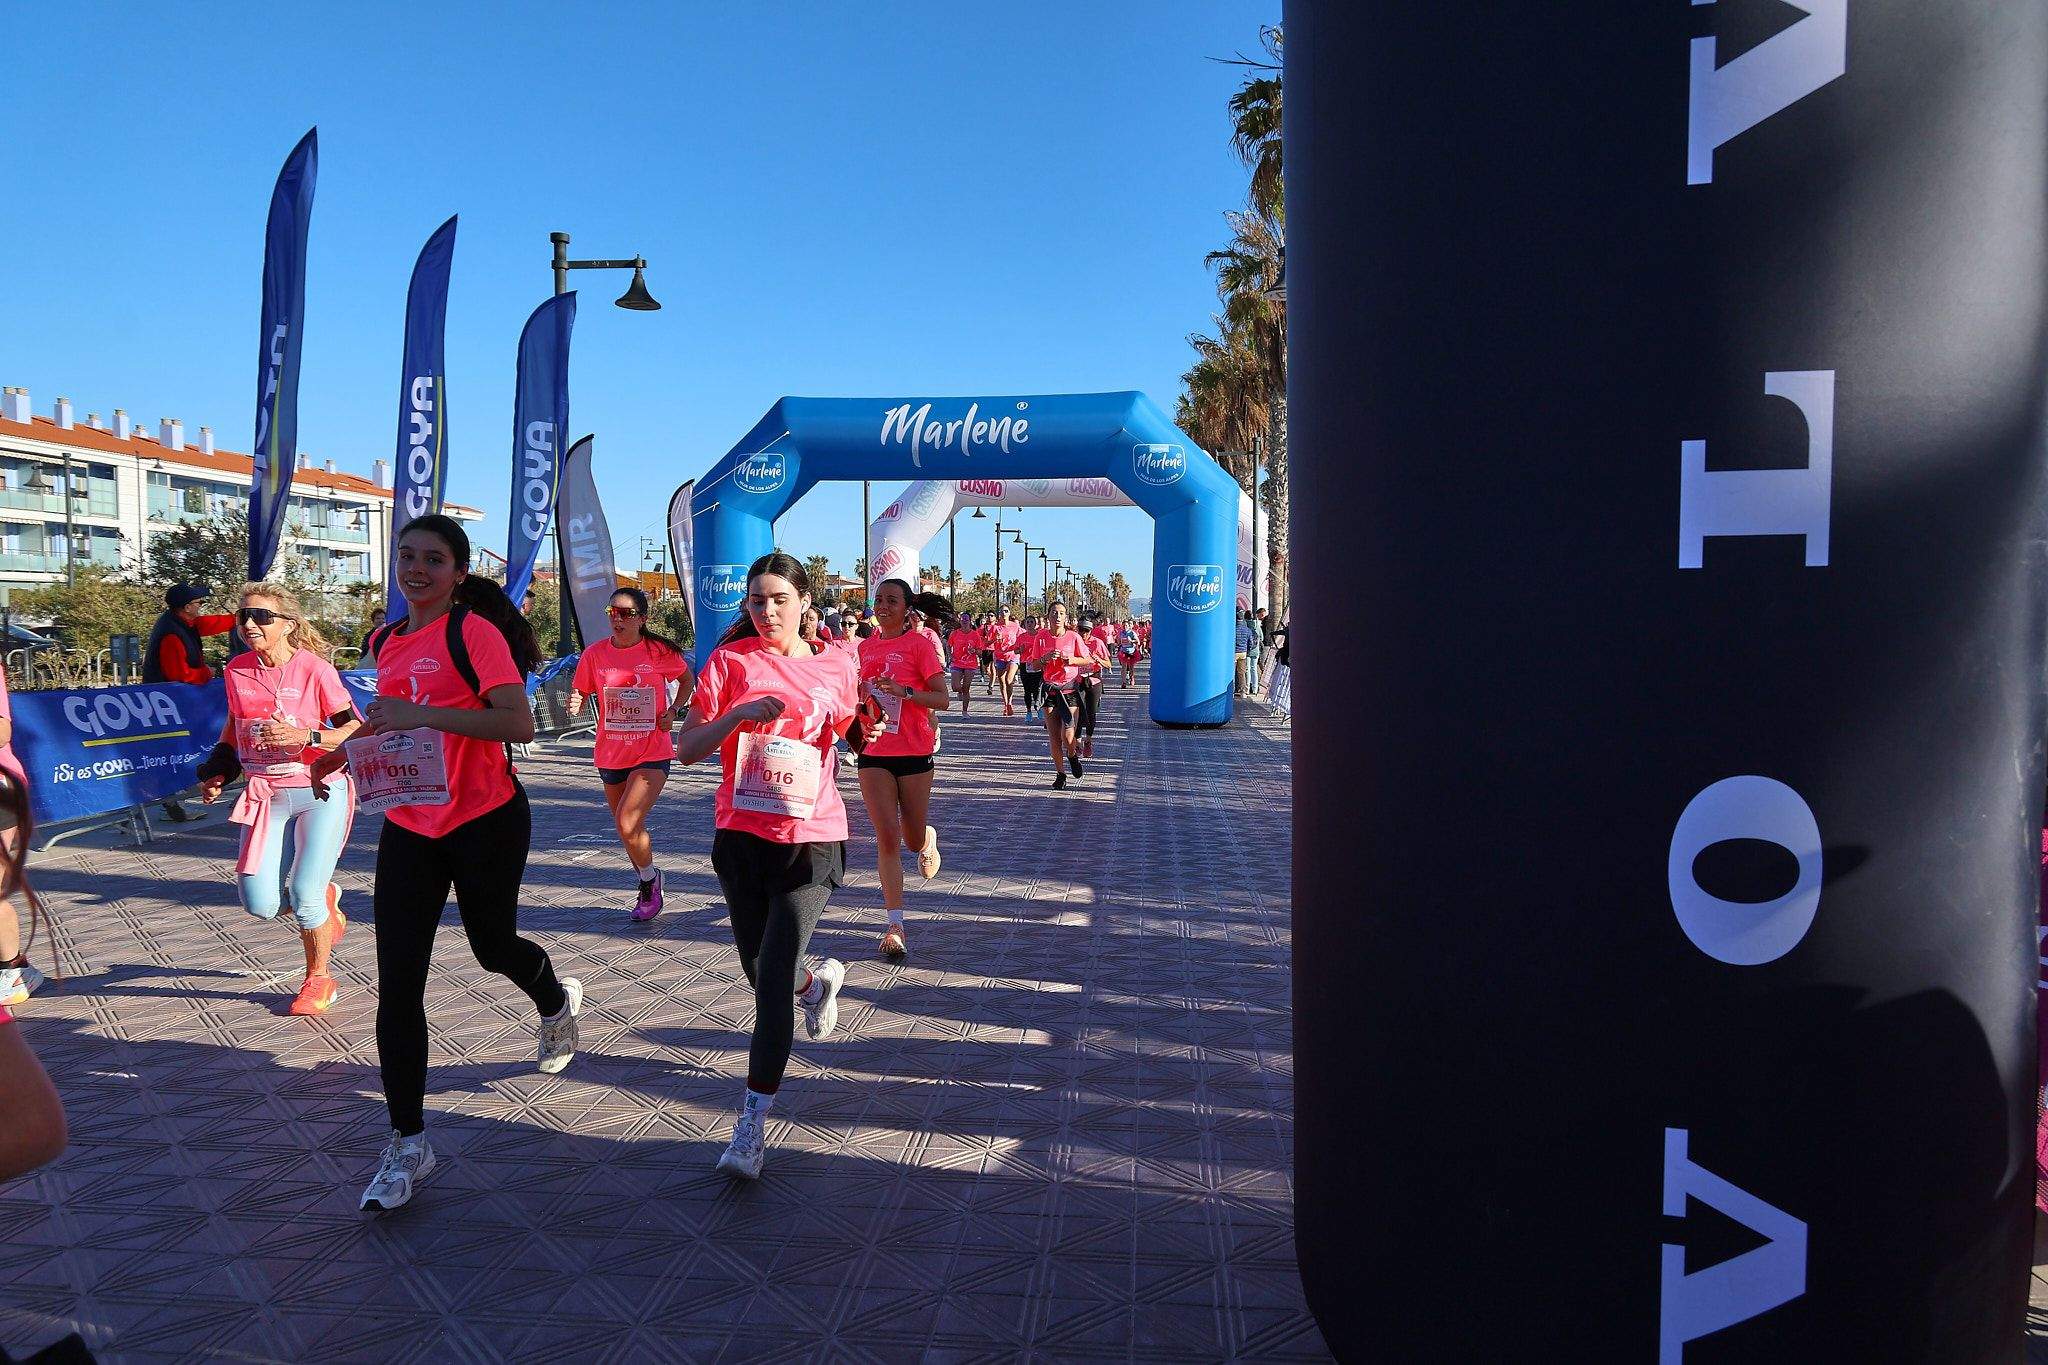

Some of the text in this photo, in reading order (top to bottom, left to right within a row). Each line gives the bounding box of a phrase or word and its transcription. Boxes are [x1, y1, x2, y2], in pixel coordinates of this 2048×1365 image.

[880, 402, 1029, 467] Marlene
[405, 376, 433, 519] GOYA
[737, 461, 782, 482] Marlene
[1137, 452, 1183, 475] Marlene
[521, 420, 553, 541] GOYA
[959, 480, 1002, 497] COSMO
[701, 575, 748, 599] Marlene
[1170, 575, 1220, 600] Marlene
[749, 679, 785, 689] OYSHO
[63, 691, 183, 737] GOYA
[53, 763, 74, 784] ¡Si
[76, 766, 92, 779] es
[92, 758, 134, 776] GOYA
[170, 754, 183, 773] que
[387, 764, 419, 777] 016
[763, 770, 794, 785] 016
[371, 796, 401, 808] OYSHO
[743, 799, 765, 808] OYSHO
